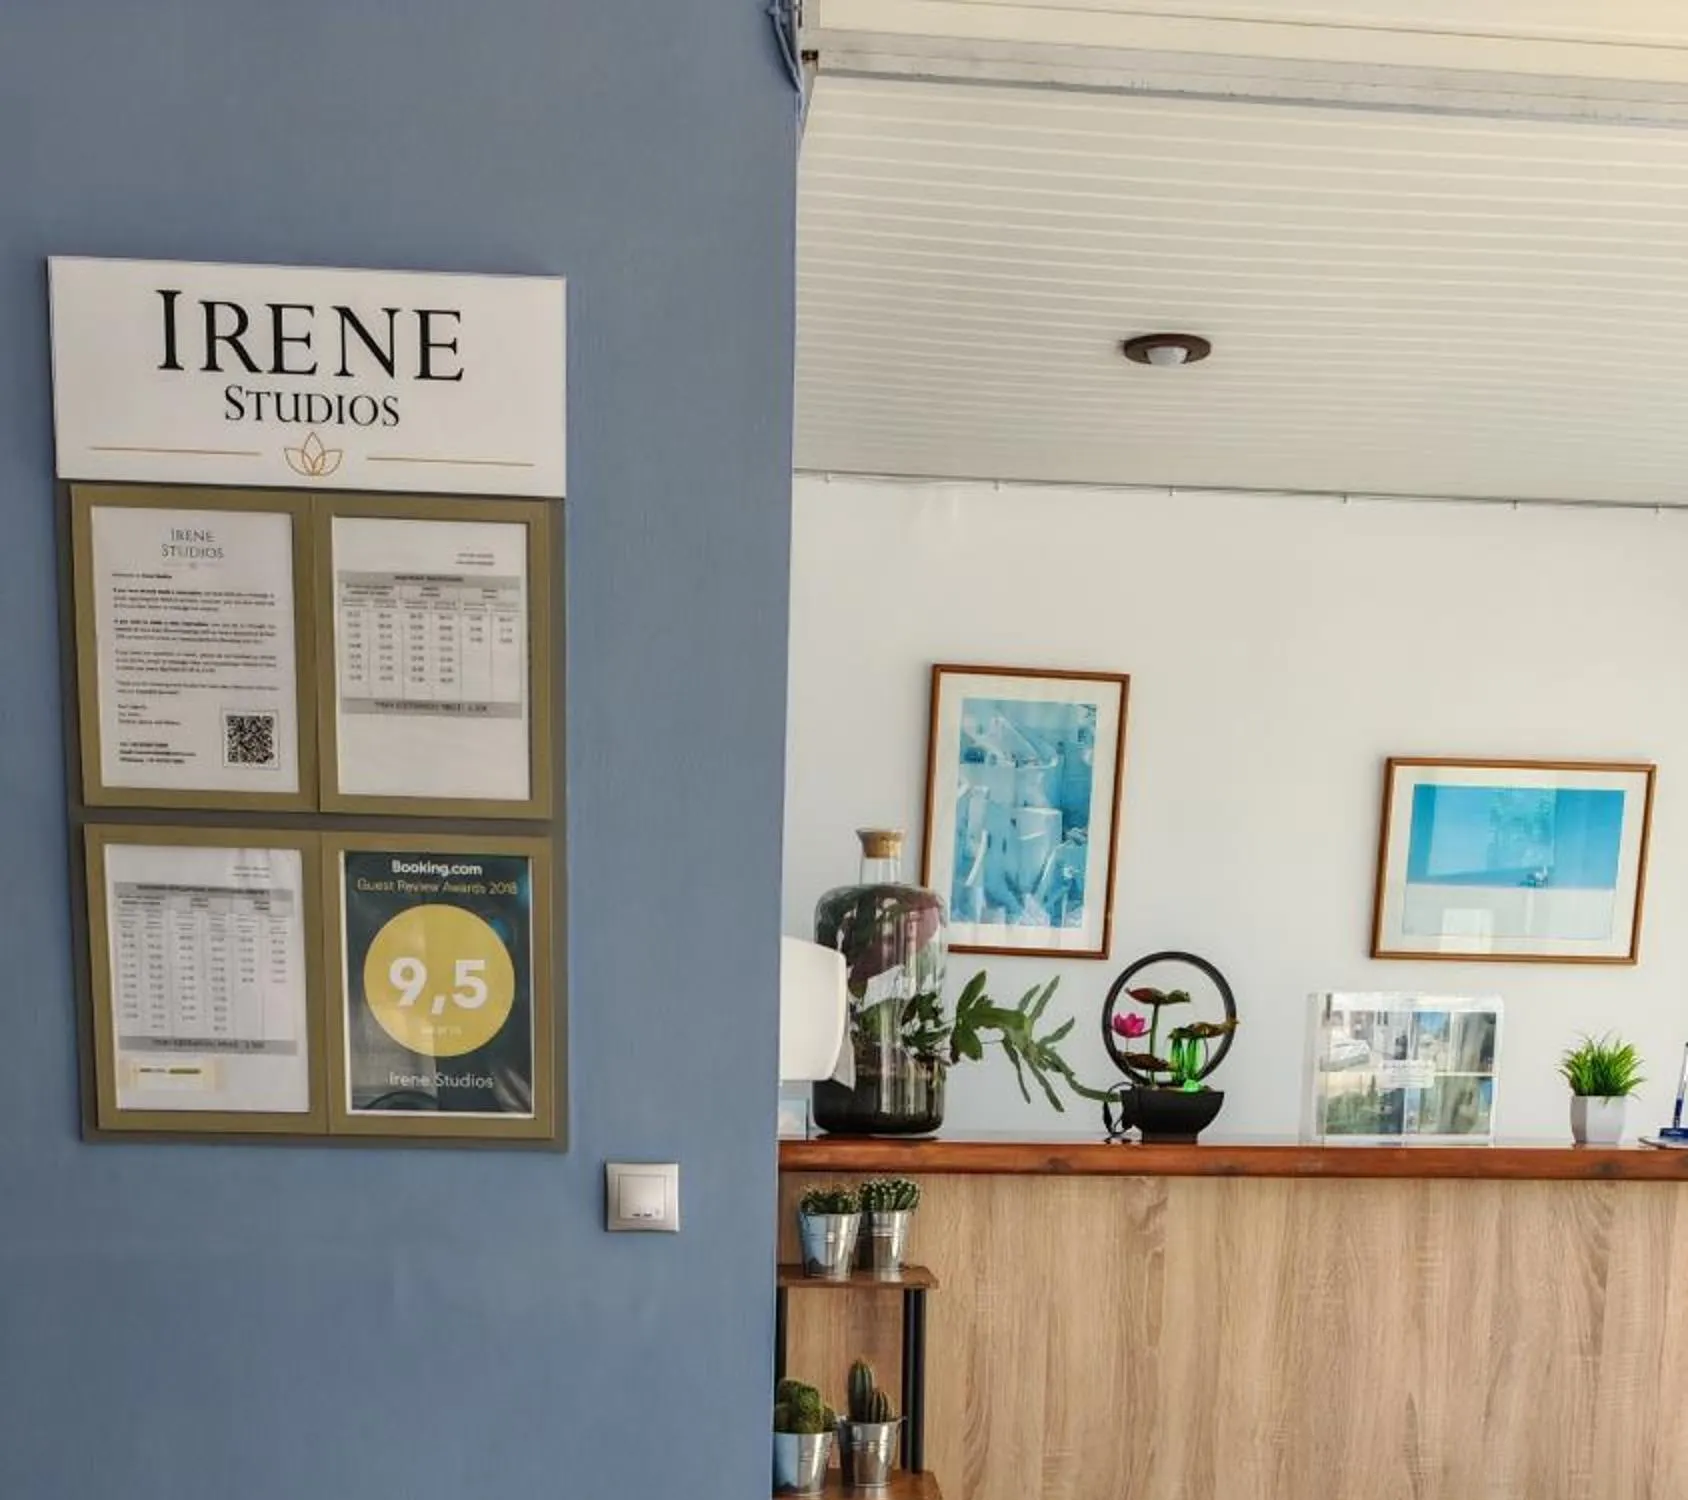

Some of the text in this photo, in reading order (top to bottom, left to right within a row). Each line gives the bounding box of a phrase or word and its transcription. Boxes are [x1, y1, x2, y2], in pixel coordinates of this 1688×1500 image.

[155, 289, 465, 382] IRENE
[223, 384, 400, 427] STUDIOS
[170, 527, 216, 543] IRENE
[160, 543, 225, 560] STUDIOS
[391, 859, 483, 877] Booking.com
[357, 877, 394, 892] Guest
[397, 879, 439, 893] Review
[442, 881, 487, 894] Awards
[388, 956, 489, 1016] 9,5
[389, 1071, 494, 1089] Irene Studios
